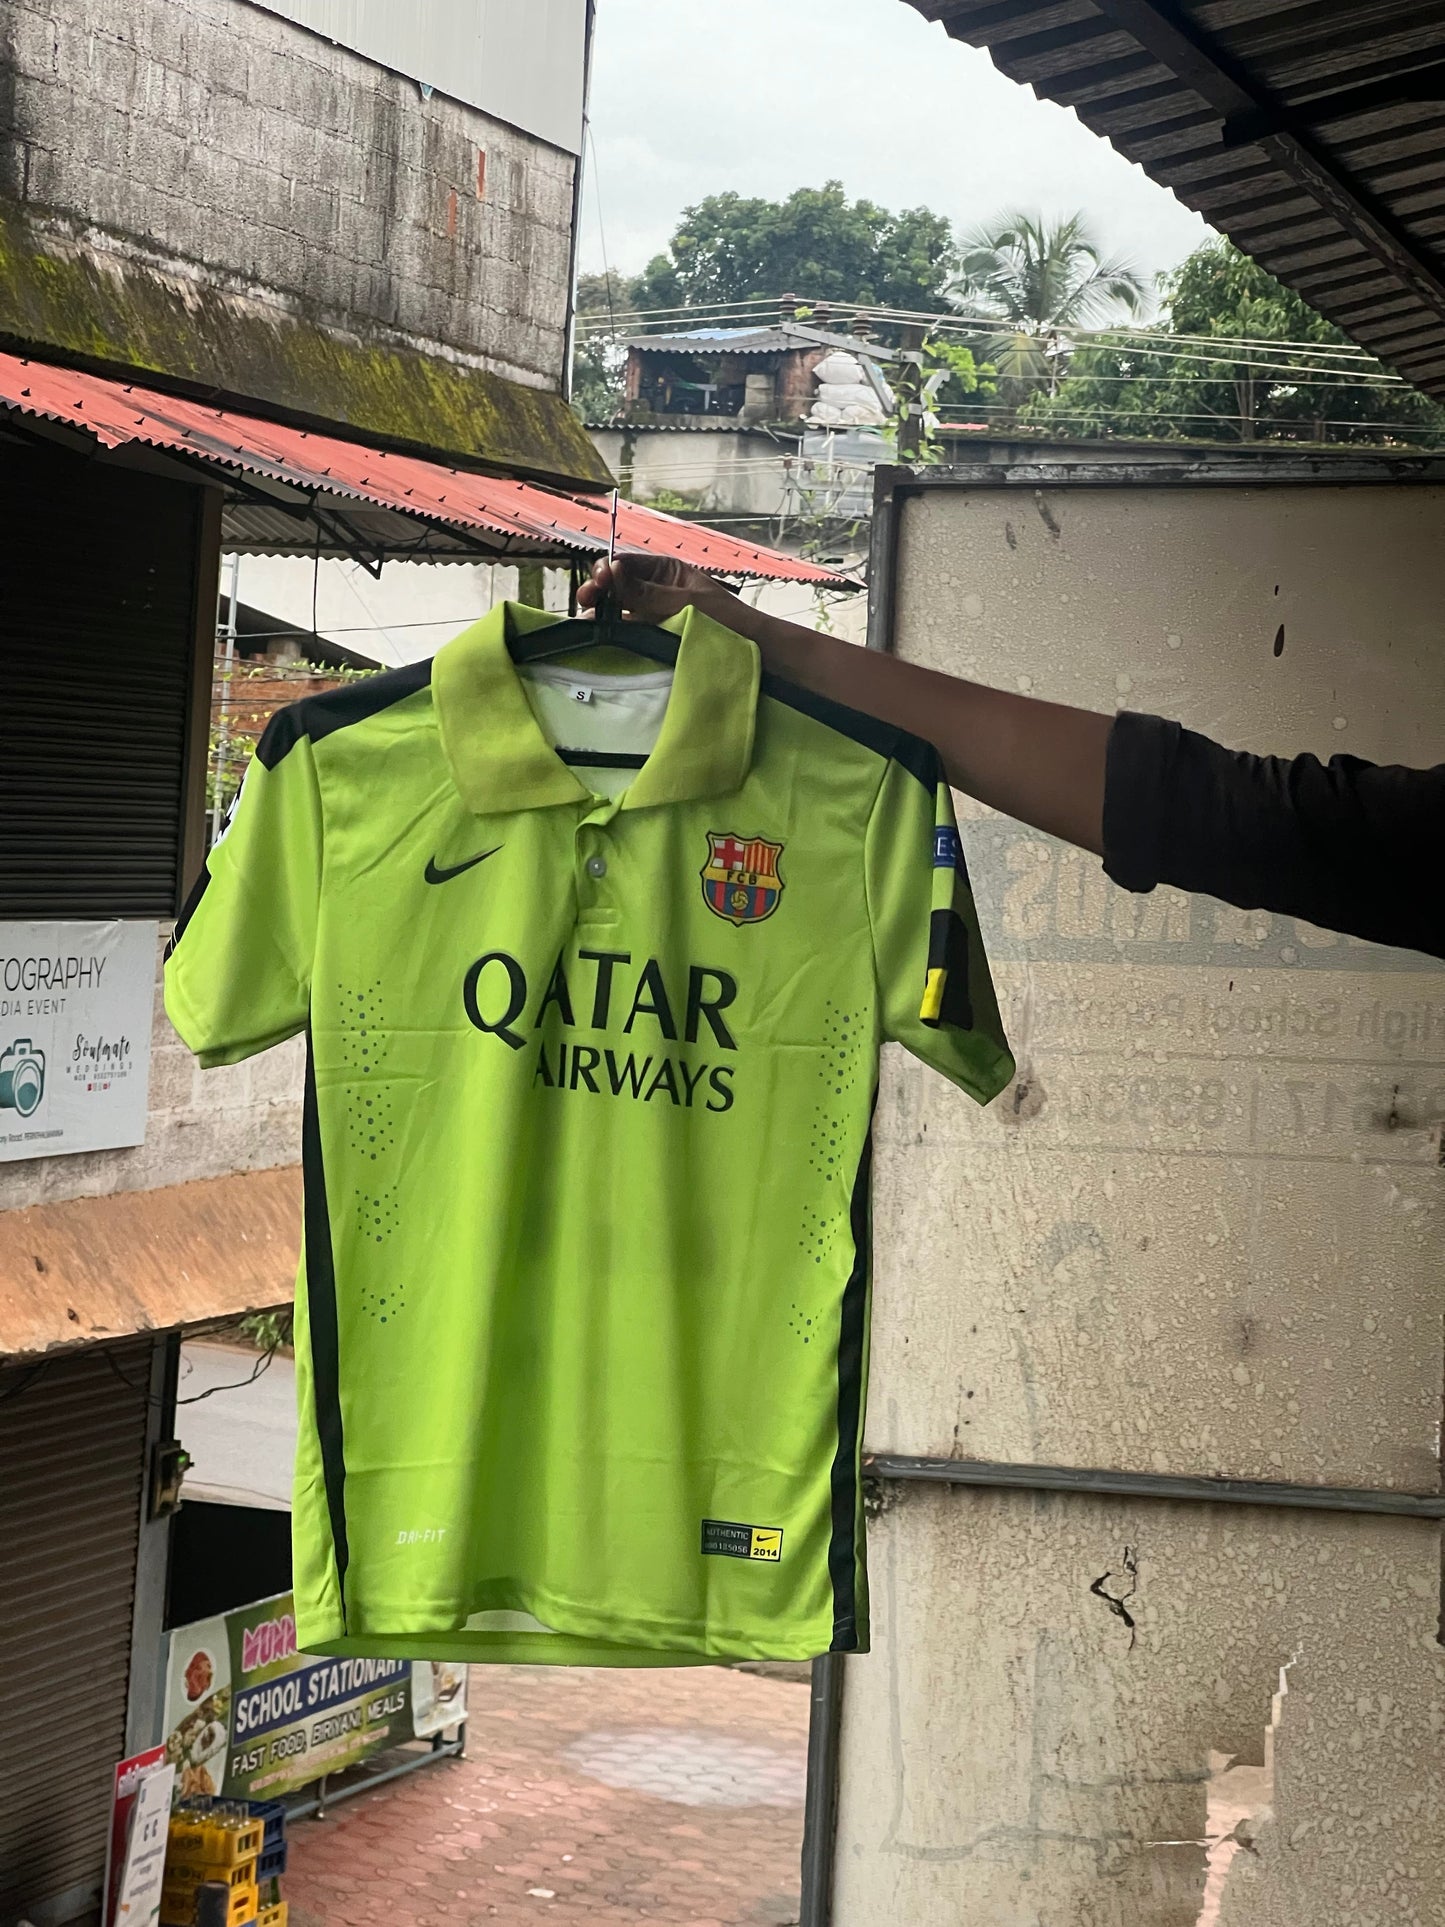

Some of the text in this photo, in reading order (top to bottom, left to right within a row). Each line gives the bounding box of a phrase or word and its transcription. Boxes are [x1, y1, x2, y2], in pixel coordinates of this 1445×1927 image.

[575, 691, 586, 701] S
[726, 870, 758, 886] FCB
[0, 957, 107, 992] OGRAPHY
[27, 999, 67, 1016] EVENT
[462, 948, 740, 1052] QATAR
[72, 1033, 131, 1063] Soulmate
[533, 1038, 736, 1113] AIRWAYS
[395, 1528, 447, 1545] DRI-FIT
[706, 1527, 750, 1541] AUTHENTIC
[753, 1547, 777, 1557] 2014
[236, 1678, 304, 1734] SCHOOL
[231, 1745, 266, 1778] FAST
[366, 1691, 406, 1723] MEALS
